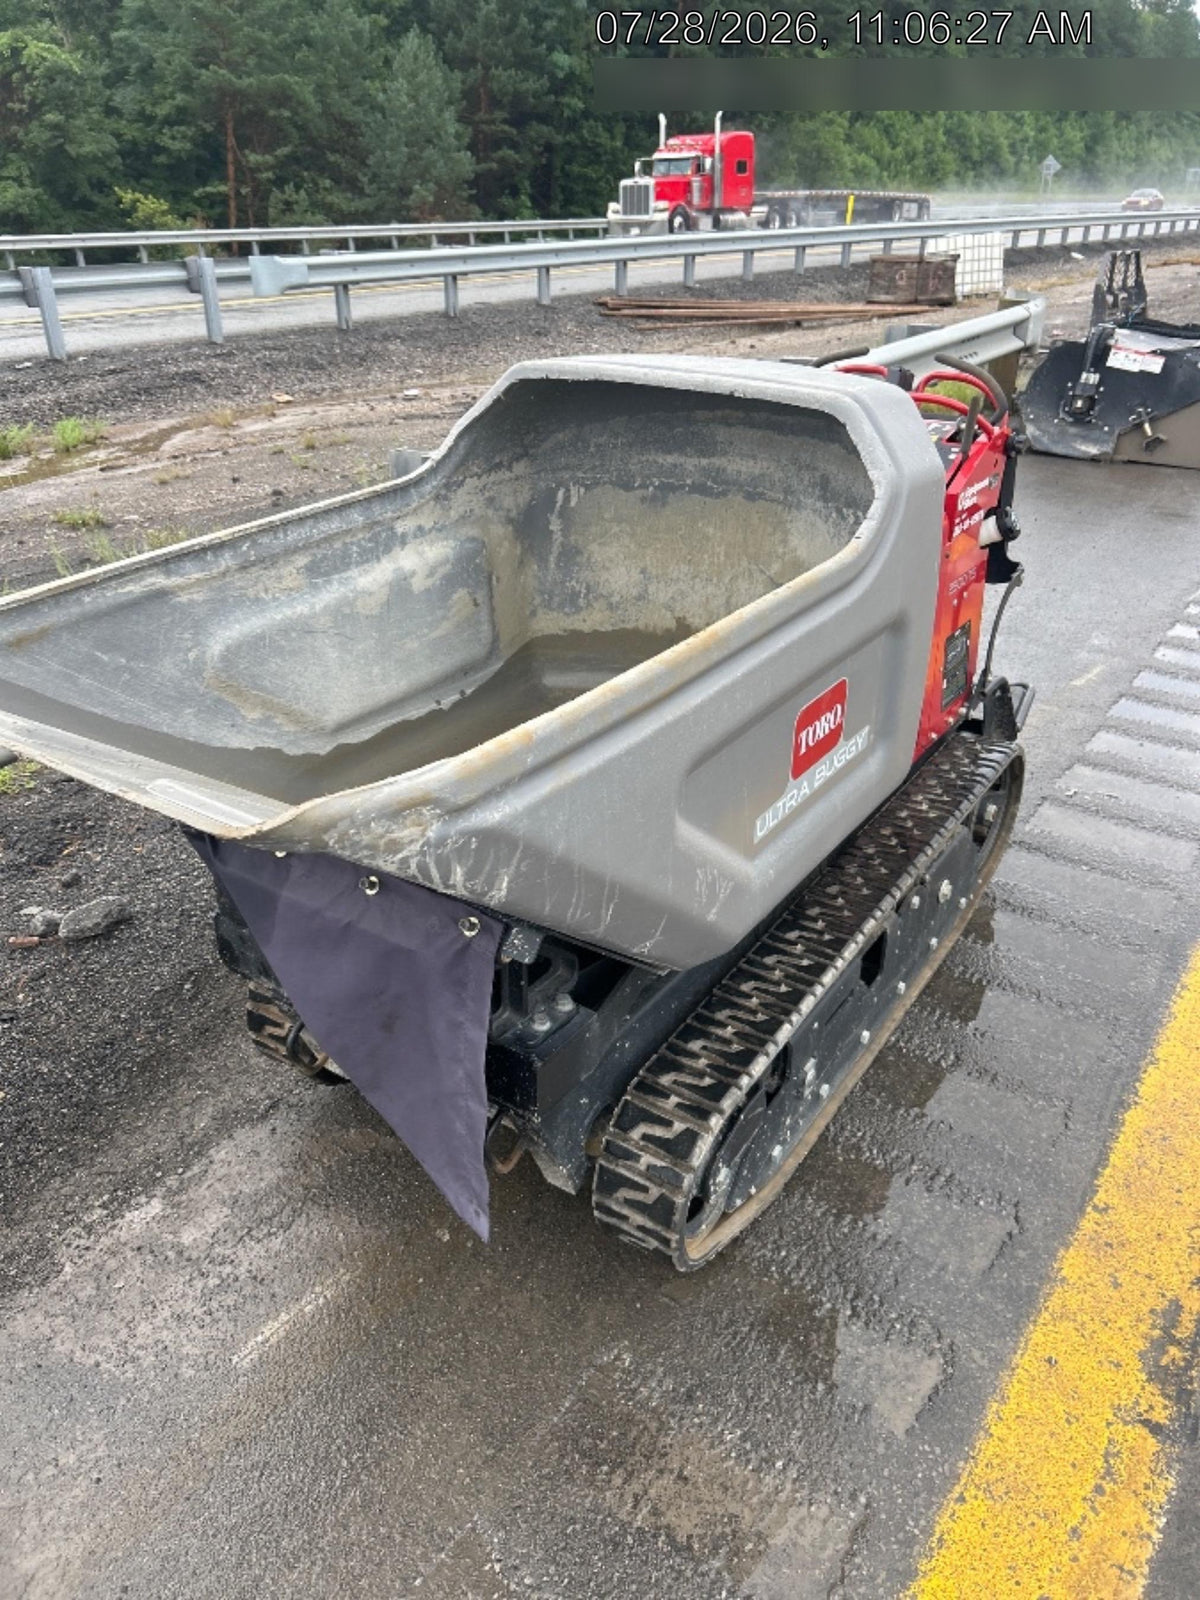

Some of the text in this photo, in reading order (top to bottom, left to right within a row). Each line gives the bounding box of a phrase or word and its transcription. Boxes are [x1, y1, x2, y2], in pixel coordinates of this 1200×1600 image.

[798, 703, 843, 756] TORO
[756, 725, 870, 837] ULTRA BUGGY
